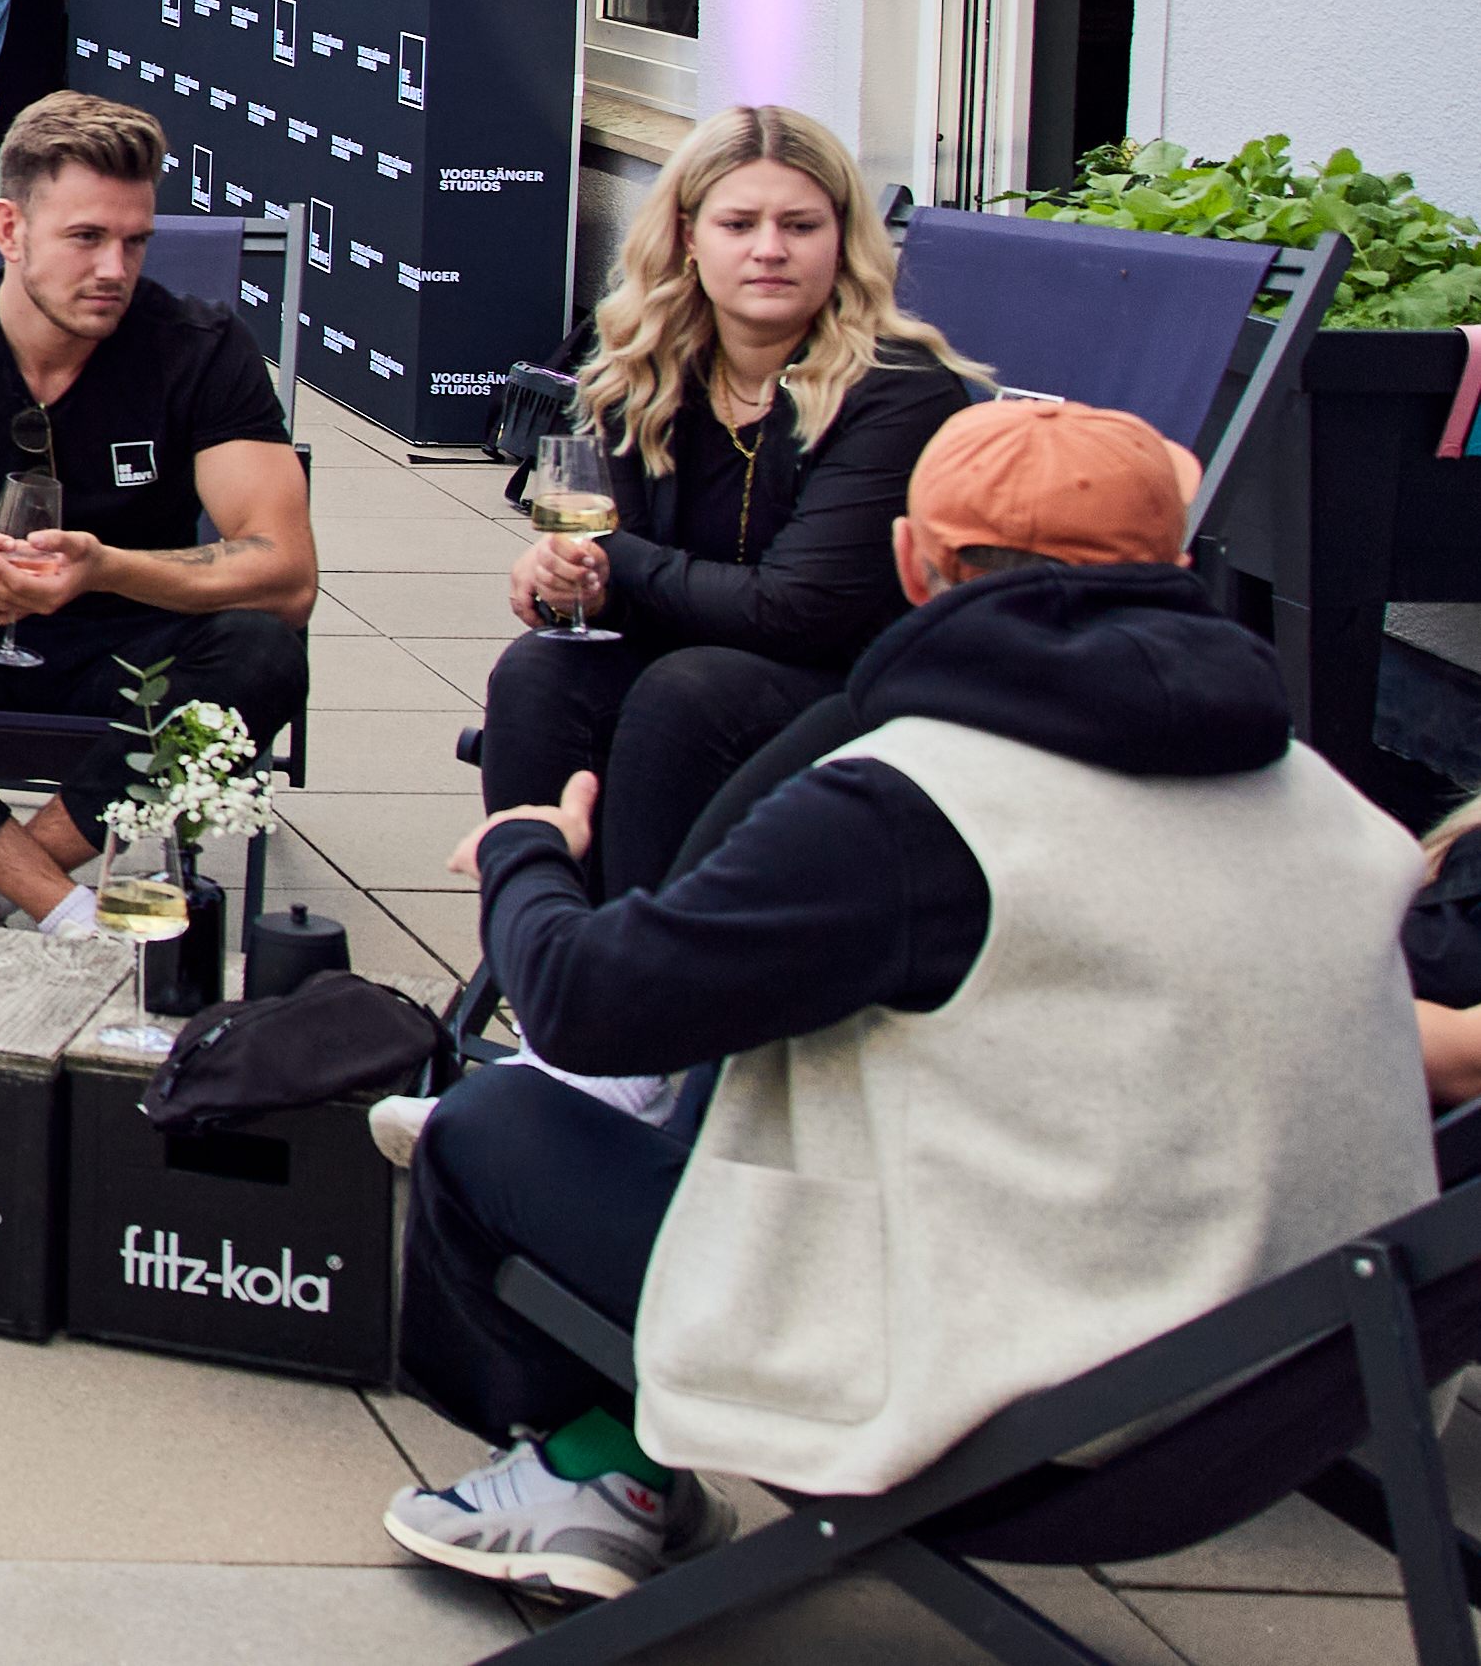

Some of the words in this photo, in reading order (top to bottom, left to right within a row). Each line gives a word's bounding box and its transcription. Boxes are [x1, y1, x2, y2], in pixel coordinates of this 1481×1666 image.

[439, 166, 545, 182] VOGELSÄNGER
[439, 180, 502, 192] STUDIOS
[430, 371, 508, 385] VOGELSÄN
[430, 384, 492, 396] STUDIOS
